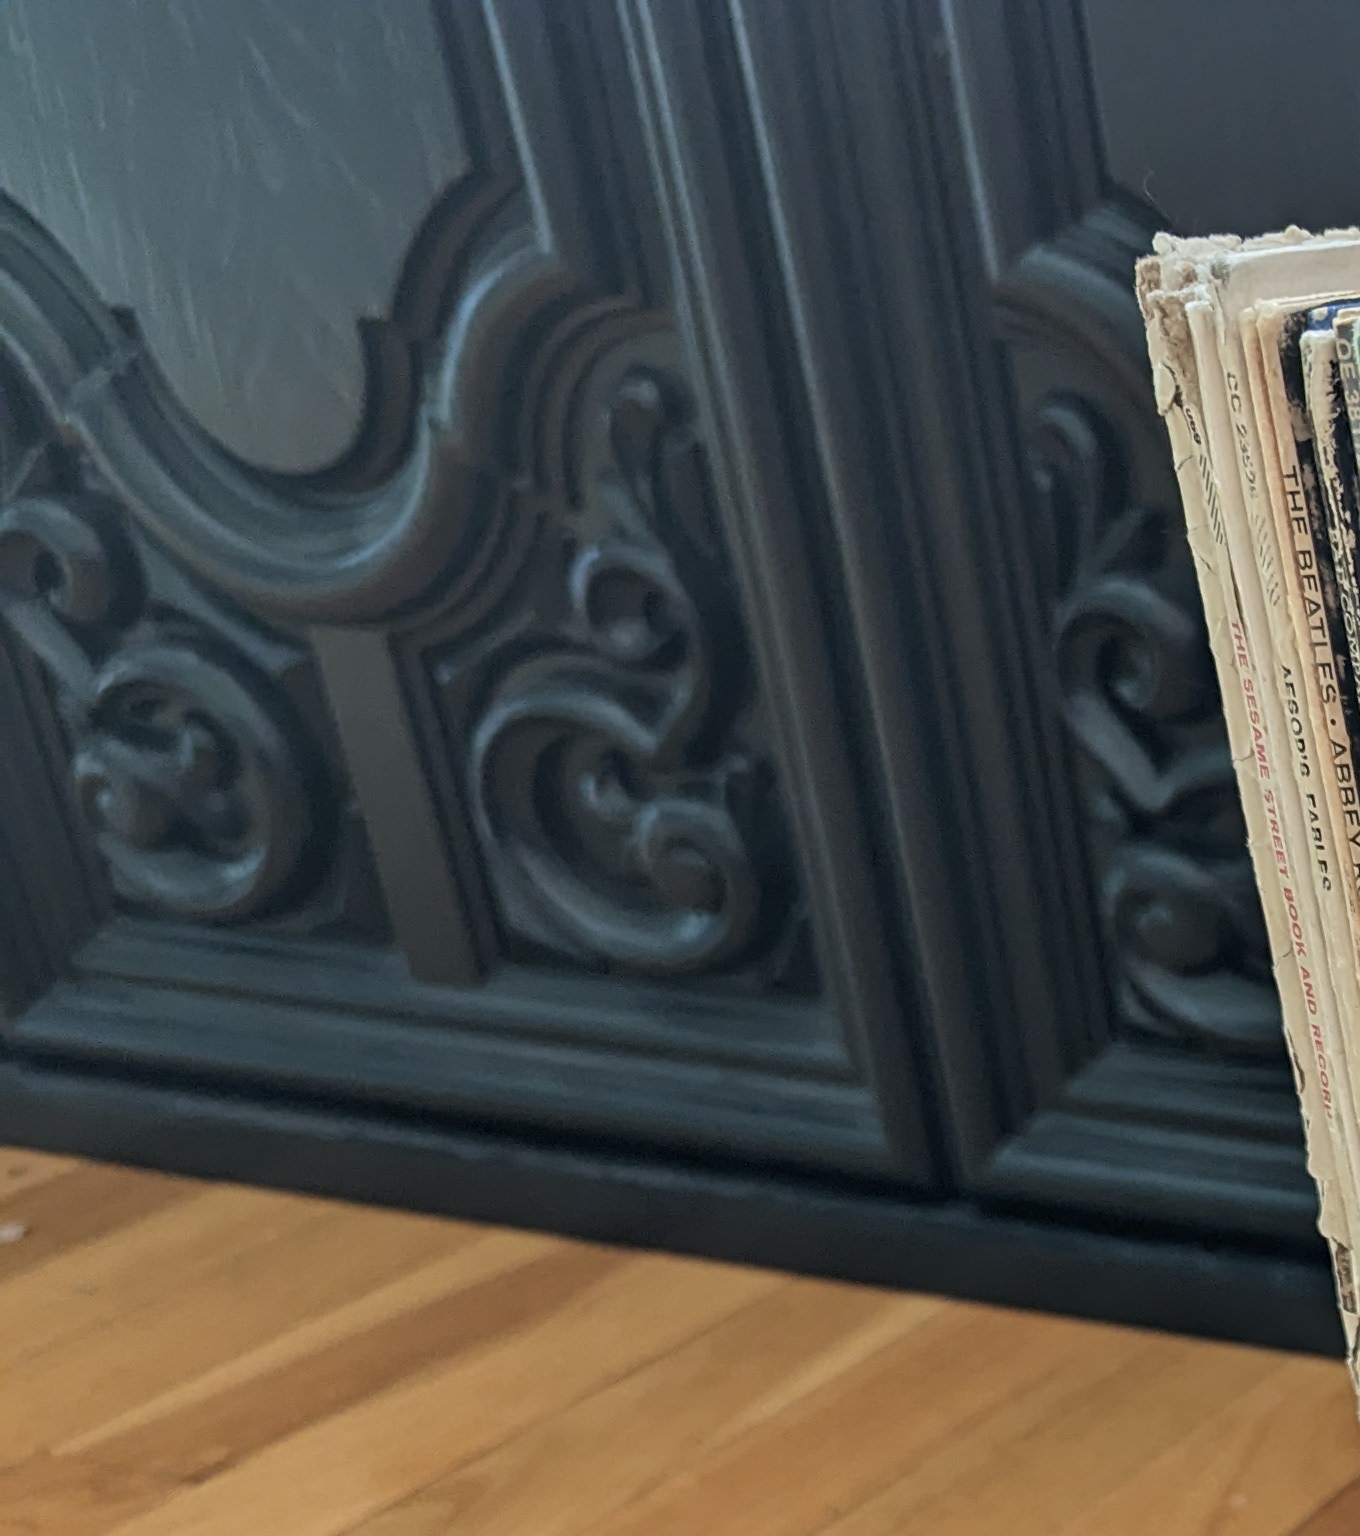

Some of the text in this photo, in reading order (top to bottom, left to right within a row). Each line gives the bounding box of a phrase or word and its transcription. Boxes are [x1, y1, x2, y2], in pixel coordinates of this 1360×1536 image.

[1283, 465, 1308, 536] THE
[1298, 549, 1337, 704] BEATLES
[1231, 621, 1248, 667] THE
[1244, 680, 1271, 780] SESAME
[1264, 790, 1289, 879] STREET
[1284, 888, 1306, 957] BOOK
[1300, 965, 1317, 1016] AND
